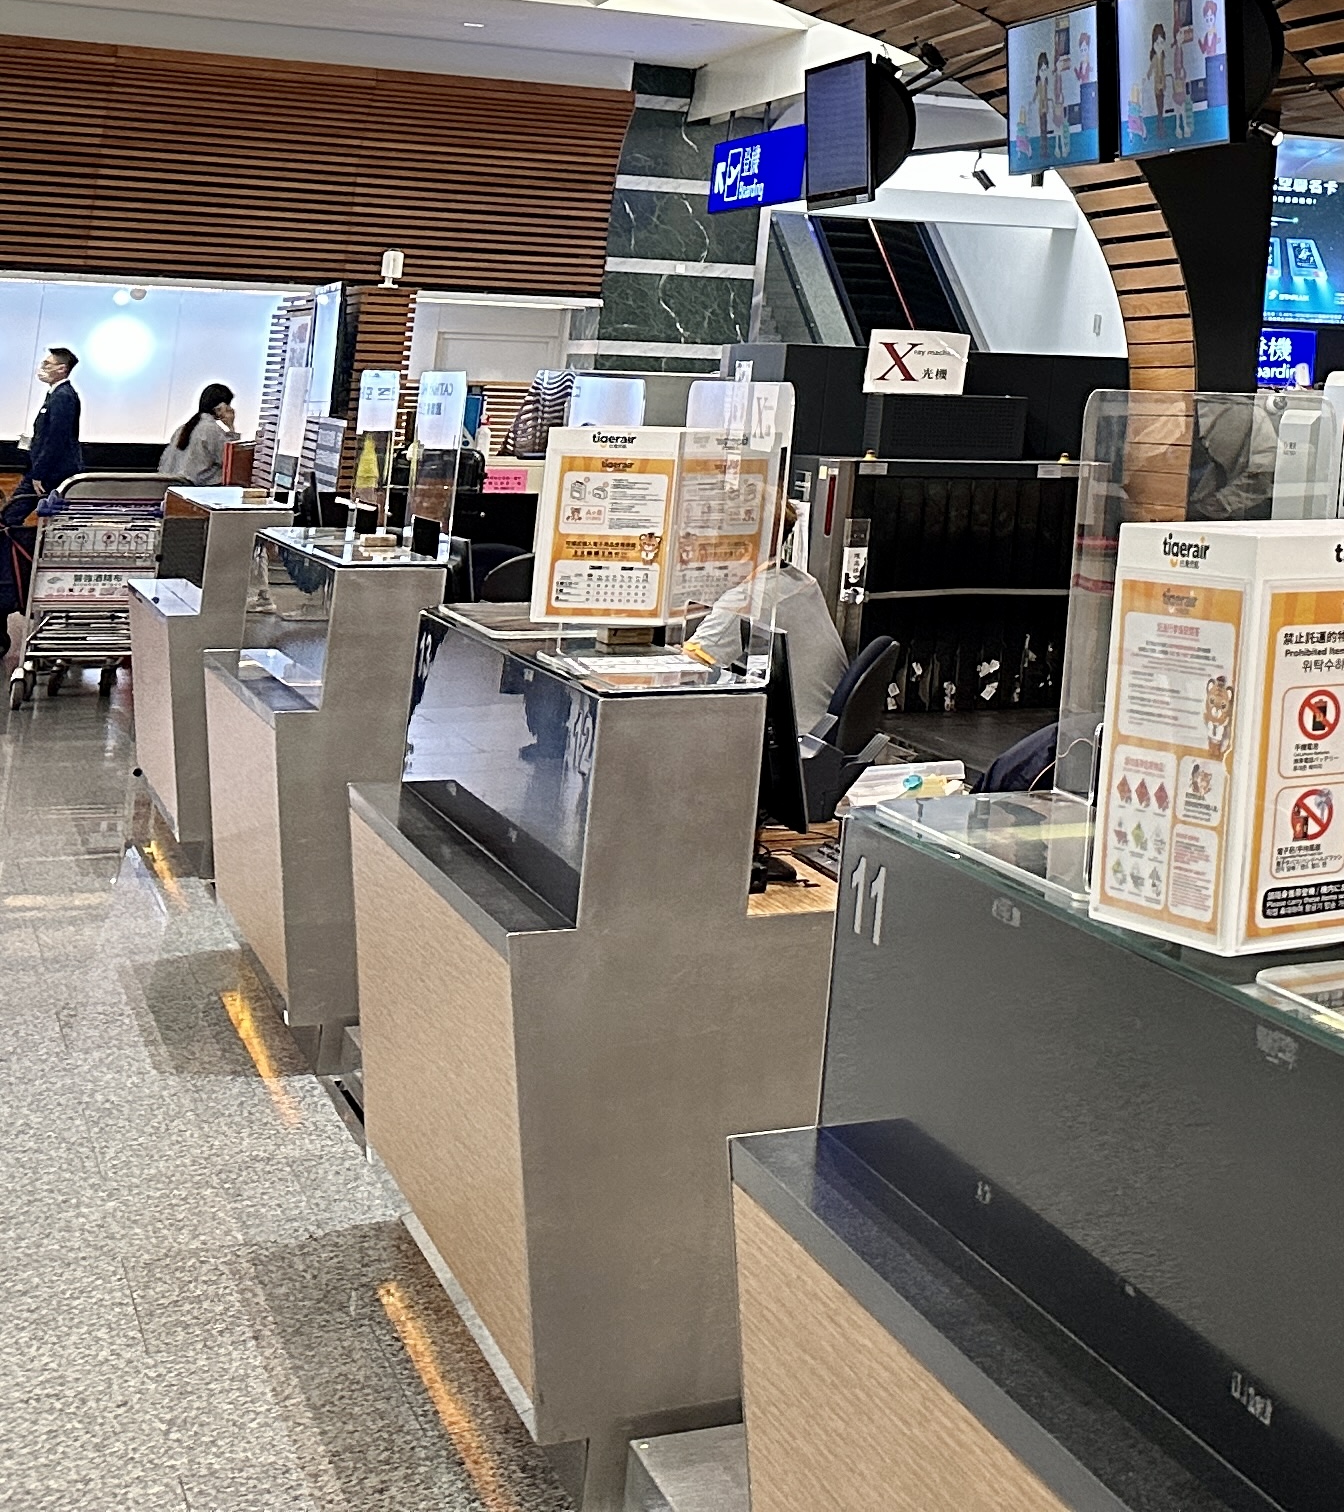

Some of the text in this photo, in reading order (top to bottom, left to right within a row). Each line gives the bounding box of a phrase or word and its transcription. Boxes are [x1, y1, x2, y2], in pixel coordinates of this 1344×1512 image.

[873, 341, 924, 382] X
[592, 431, 637, 448] tigerair
[1162, 533, 1210, 567] tigerair
[1285, 648, 1327, 657] Prohibited
[851, 856, 887, 946] 11
